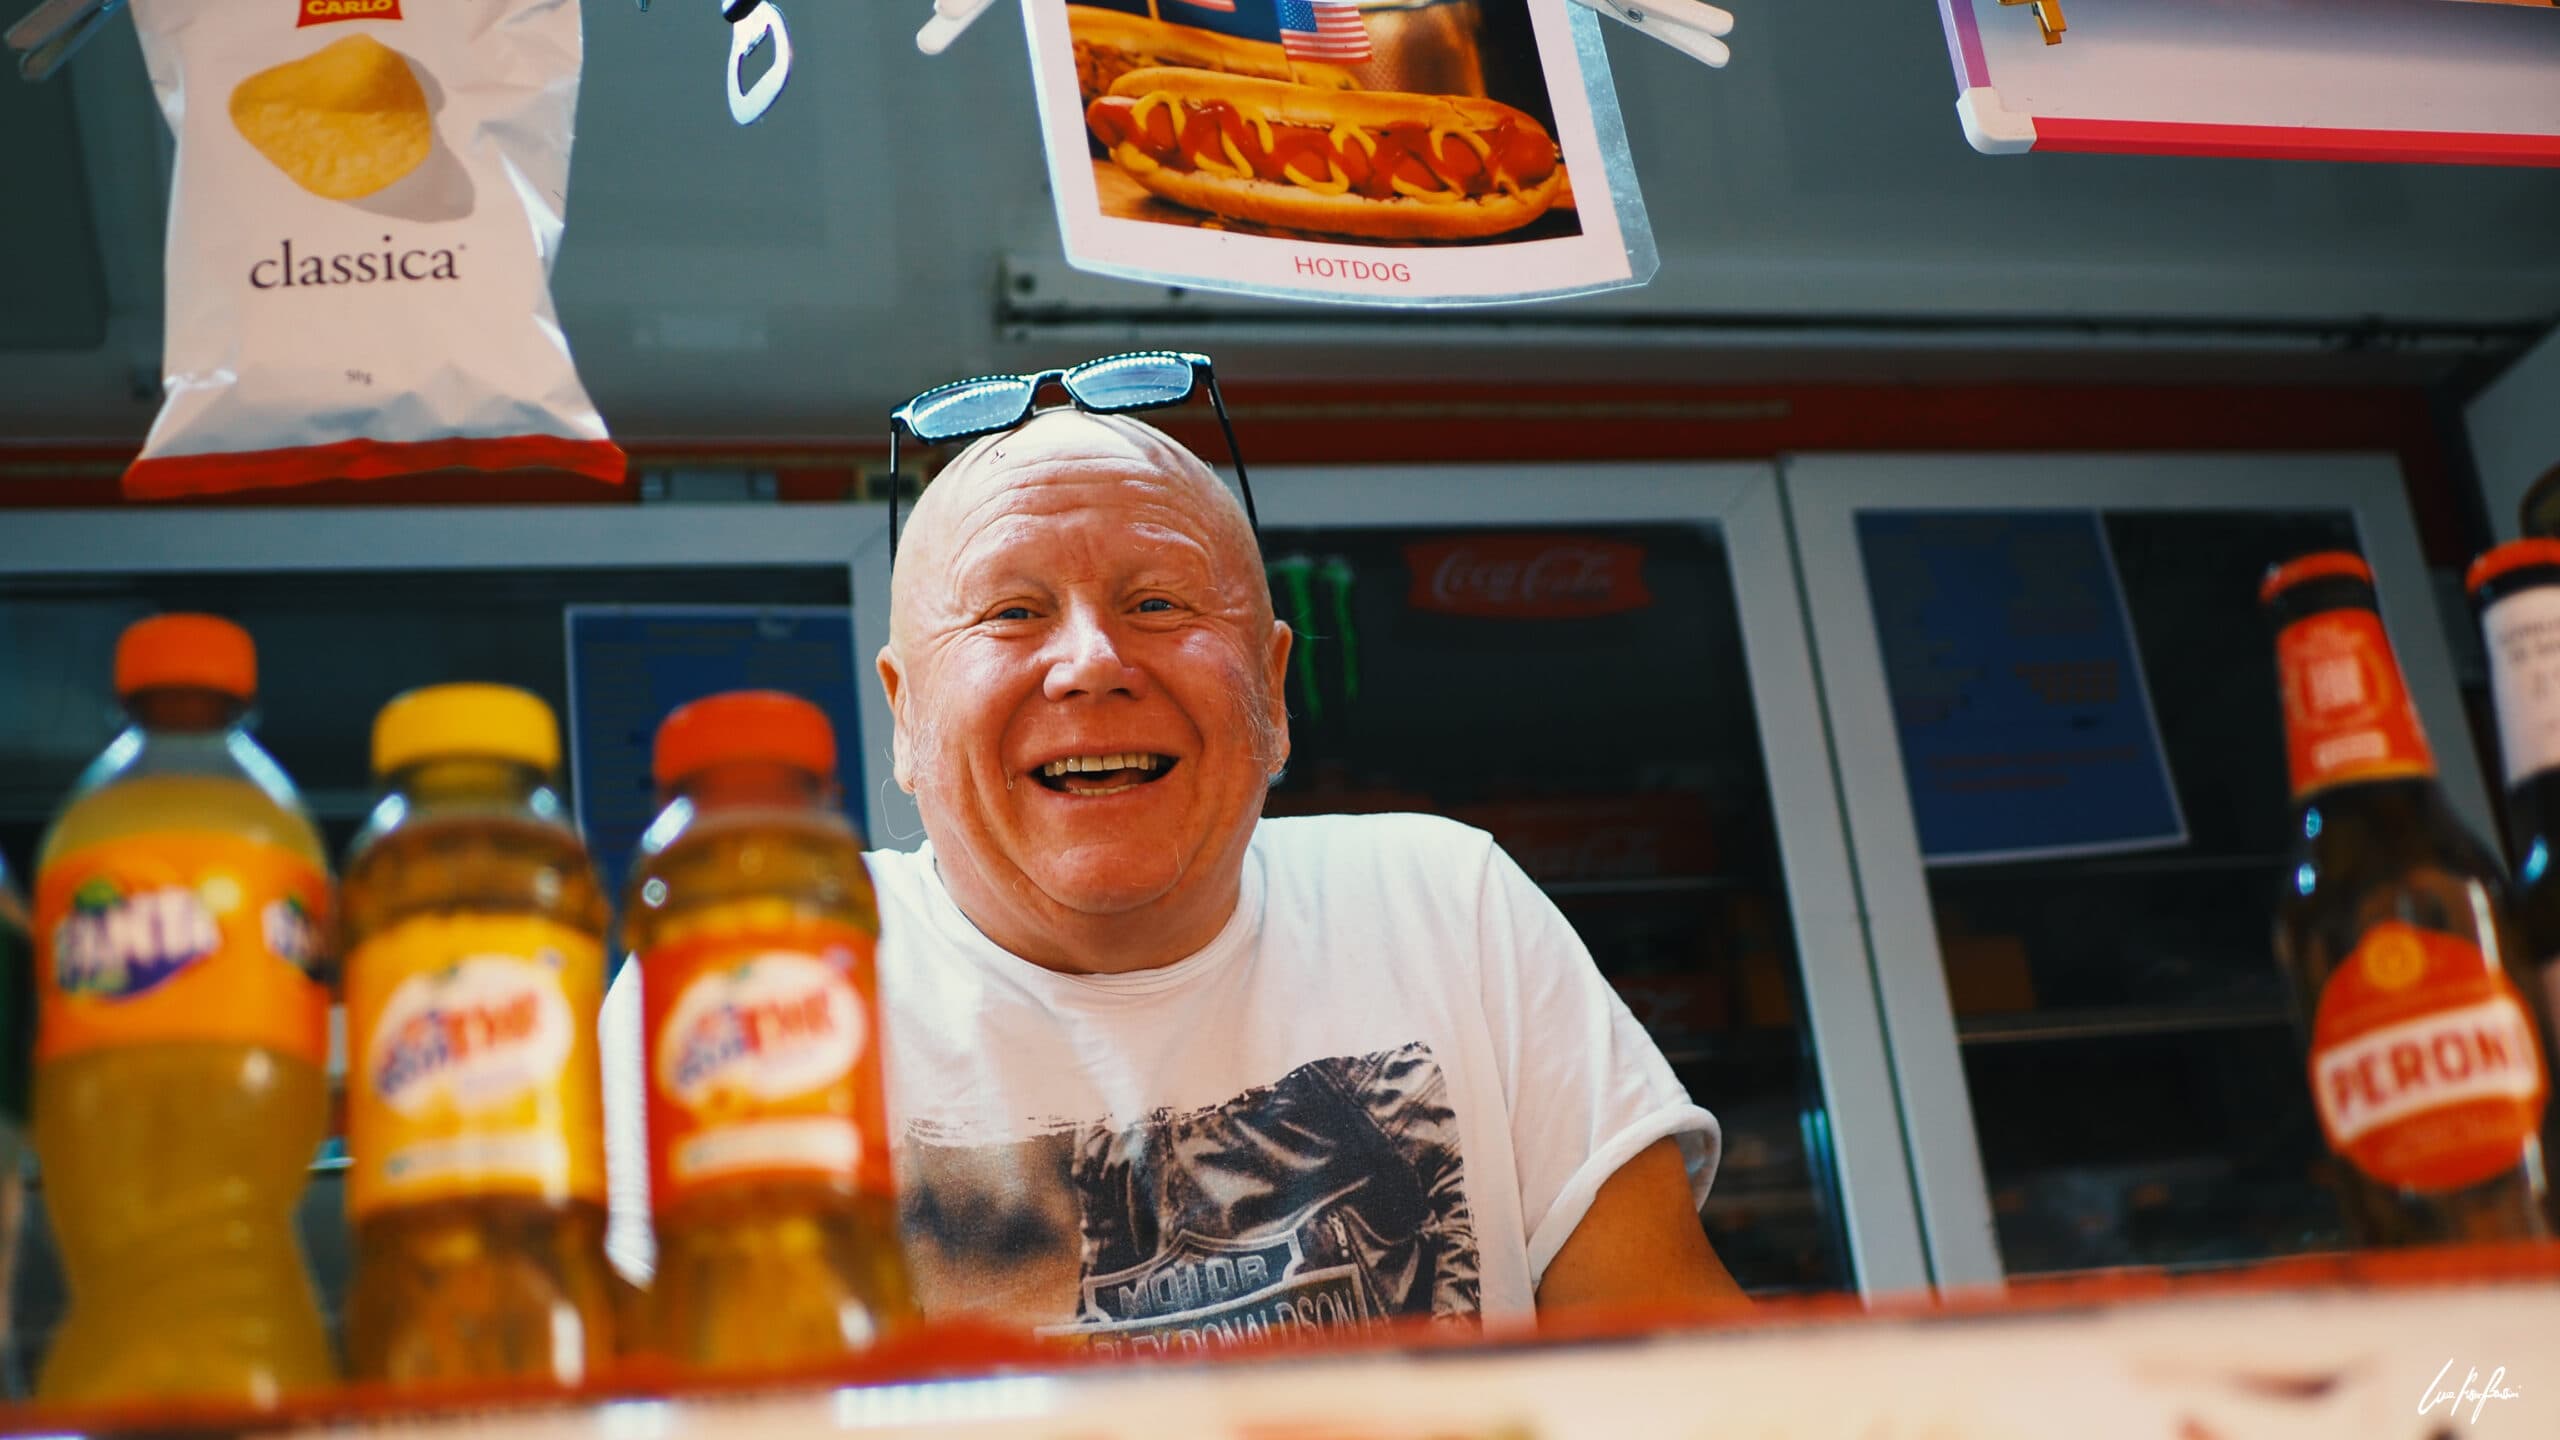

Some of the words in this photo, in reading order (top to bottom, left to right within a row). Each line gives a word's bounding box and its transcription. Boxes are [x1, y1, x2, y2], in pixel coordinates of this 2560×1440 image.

[306, 0, 393, 15] CARLO
[249, 234, 459, 289] classica
[1294, 255, 1411, 282] HOTDOG
[1117, 1254, 1269, 1318] MOTOR
